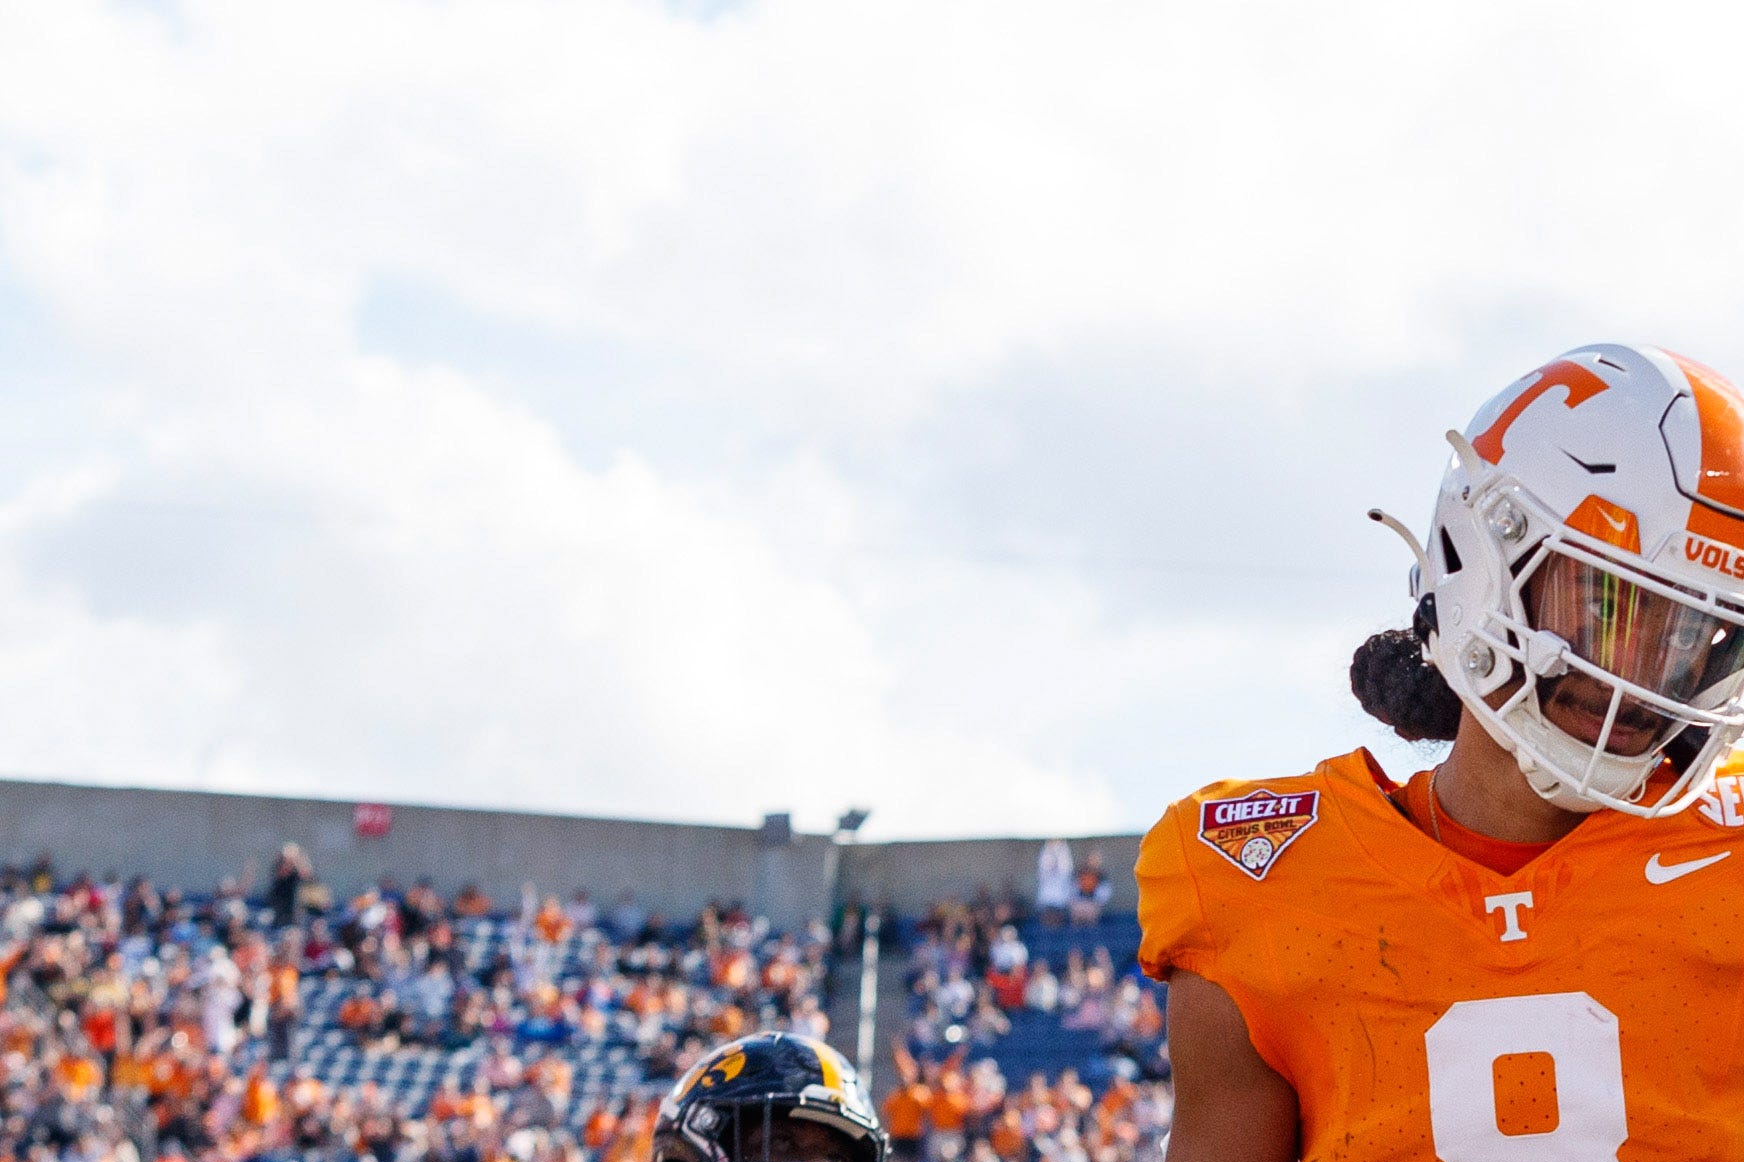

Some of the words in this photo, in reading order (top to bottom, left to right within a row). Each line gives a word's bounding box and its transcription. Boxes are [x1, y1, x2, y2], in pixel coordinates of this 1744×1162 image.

[1217, 823, 1260, 840] CITRUS
[1264, 819, 1298, 832] BOWL
[1484, 891, 1534, 942] T
